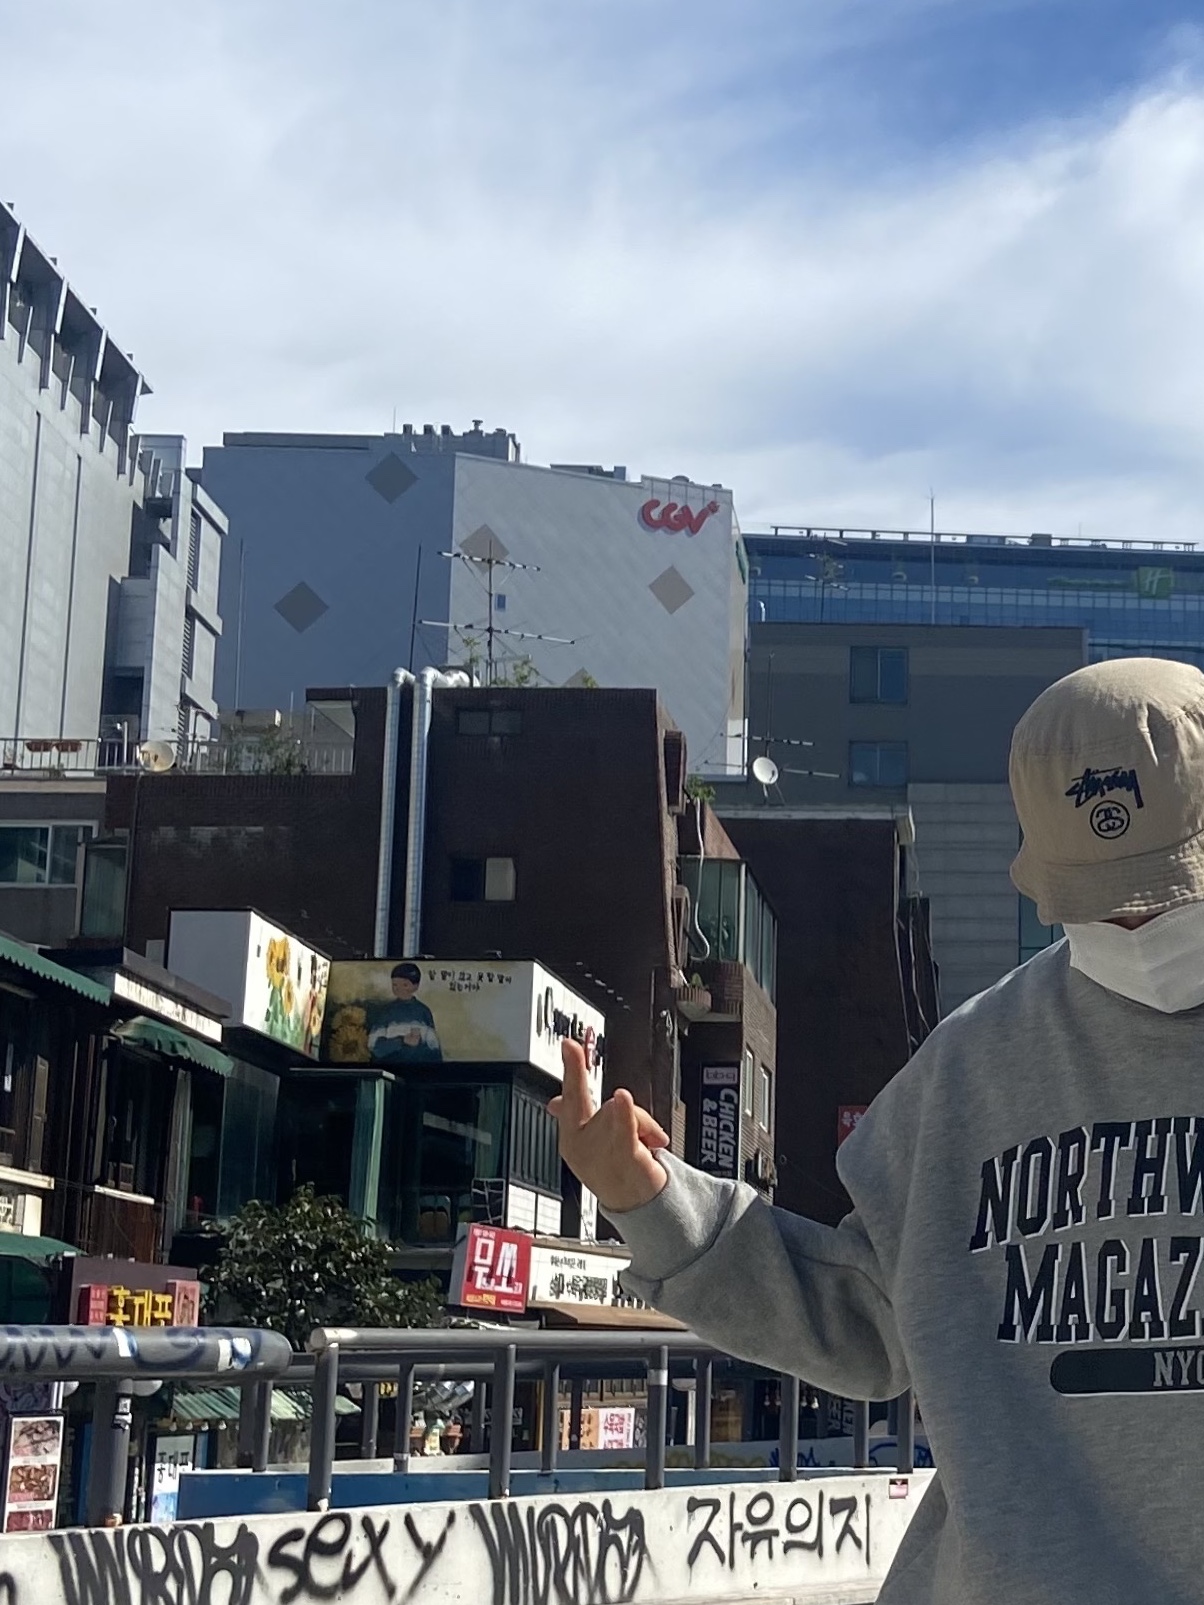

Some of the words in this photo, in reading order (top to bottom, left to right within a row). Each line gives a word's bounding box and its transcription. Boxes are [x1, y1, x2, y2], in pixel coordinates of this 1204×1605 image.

[641, 499, 709, 535] CGV
[702, 1098, 718, 1113] &
[718, 1088, 738, 1169] CHICKEN
[701, 1114, 718, 1164] BEER
[686, 1489, 872, 1572] 자유의지
